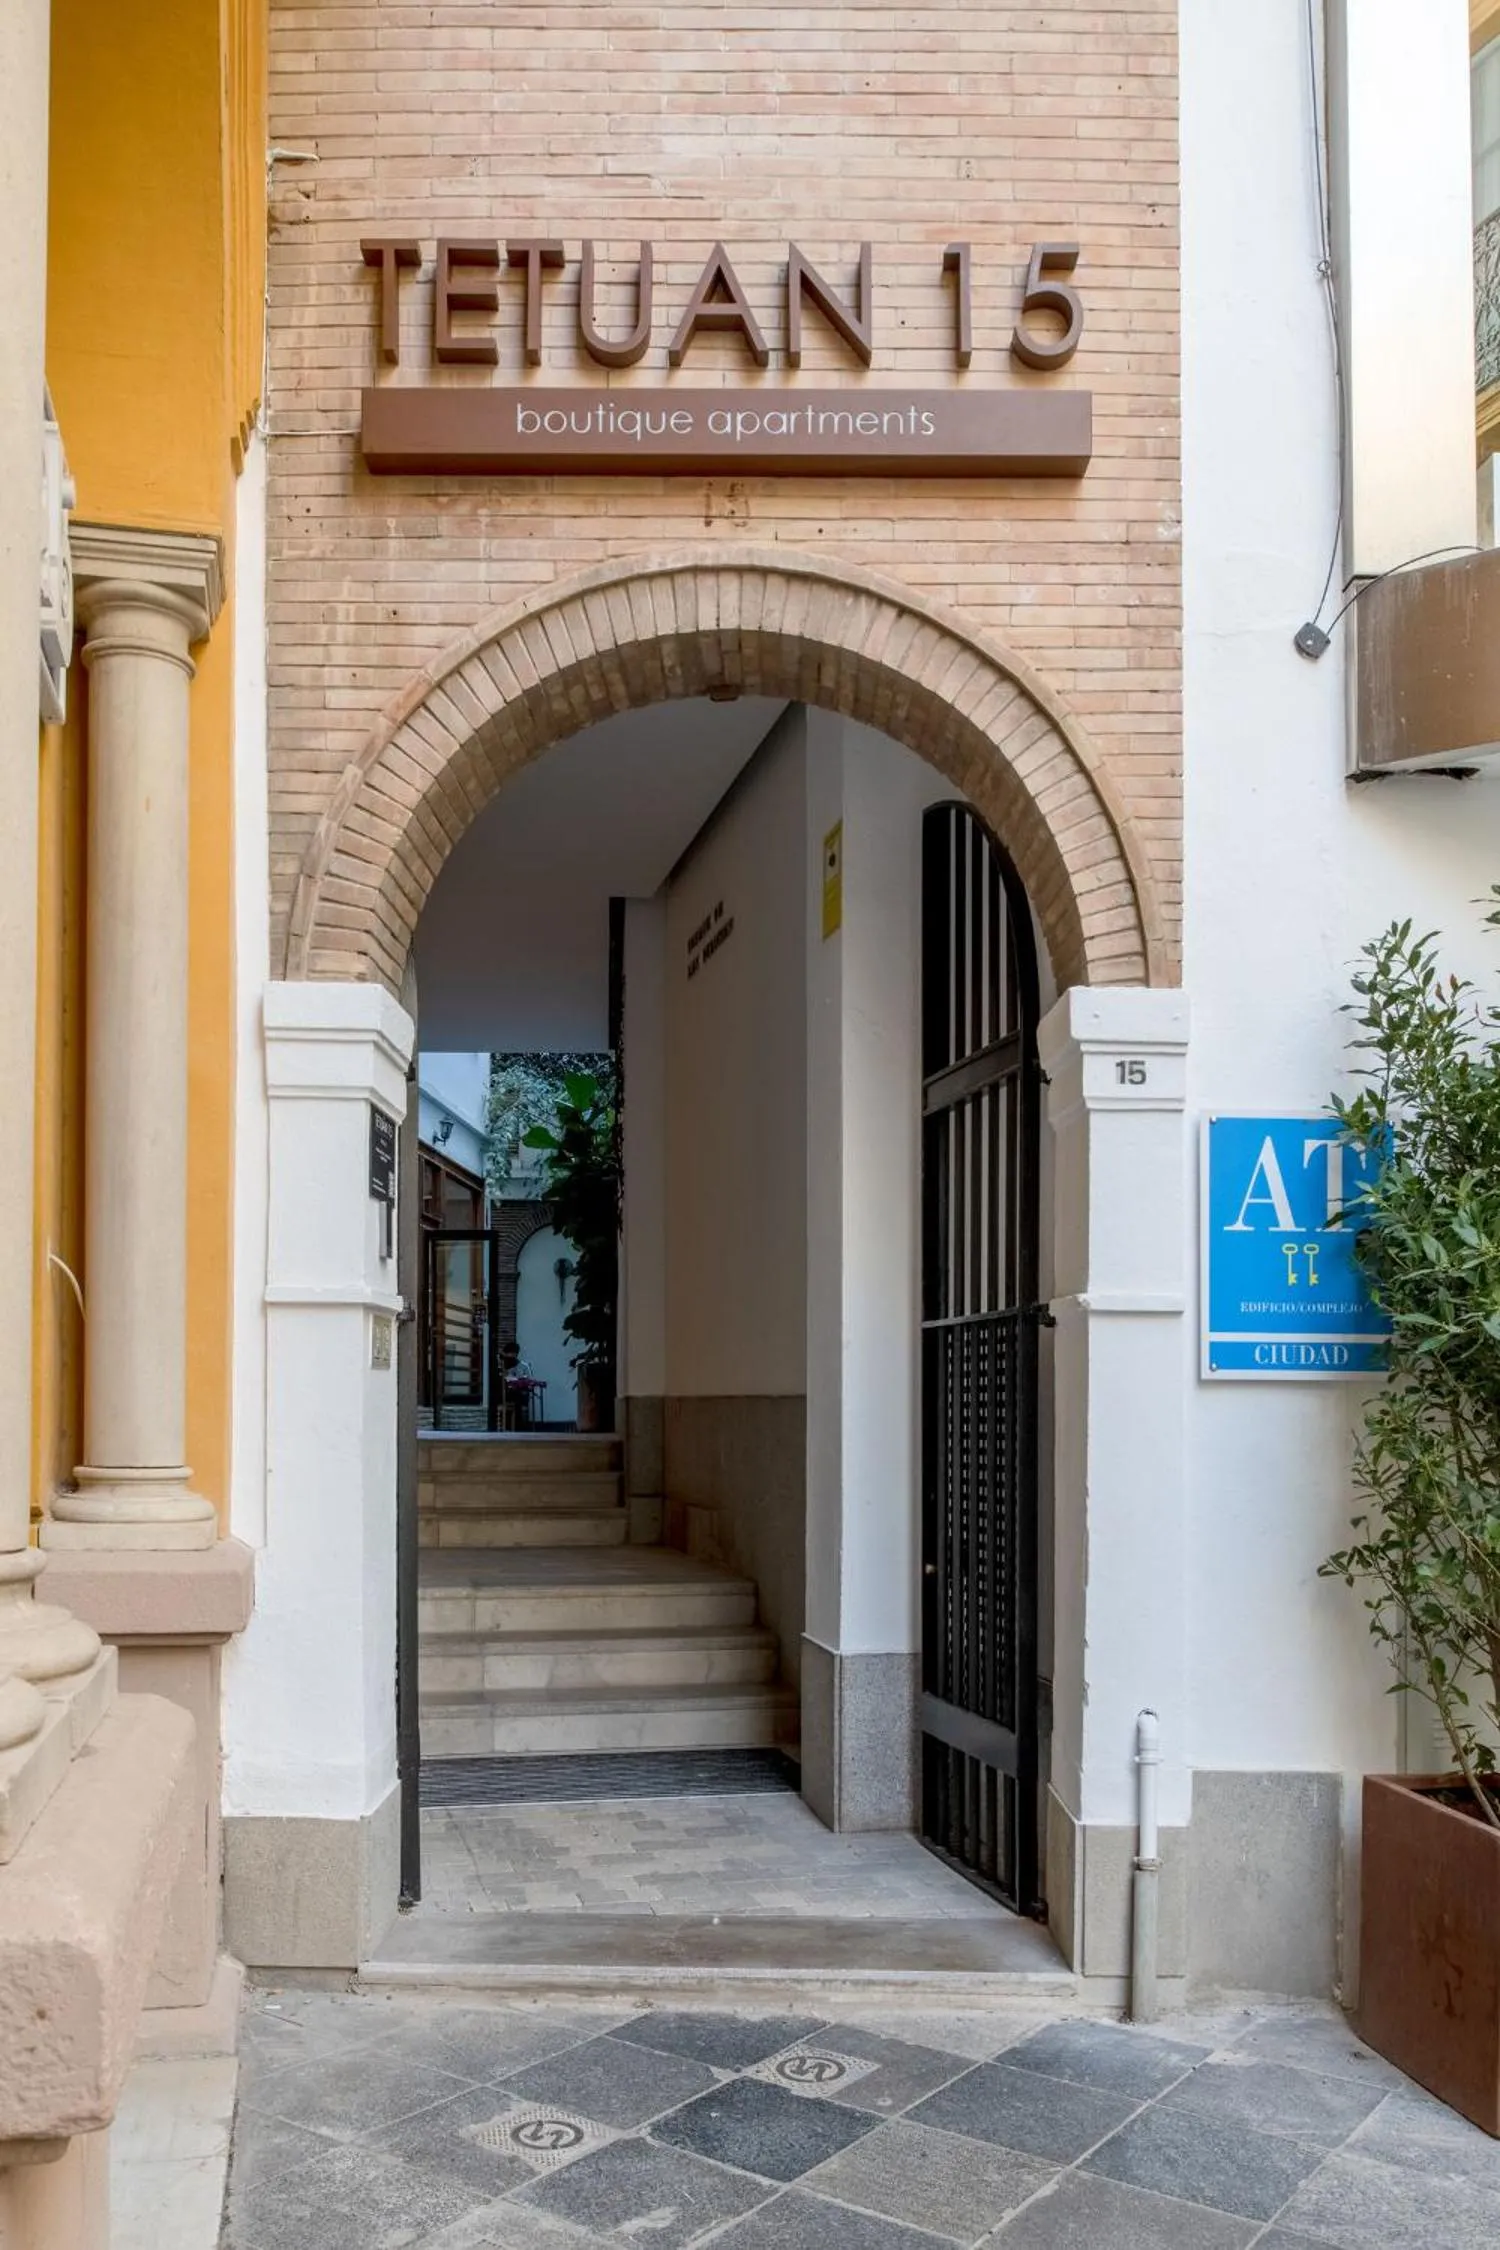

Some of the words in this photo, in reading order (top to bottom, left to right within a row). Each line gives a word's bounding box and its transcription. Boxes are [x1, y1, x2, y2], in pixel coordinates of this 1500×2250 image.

[360, 238, 873, 369] TETUAN
[942, 241, 1085, 371] 15
[516, 402, 694, 442] boutique
[707, 404, 936, 442] apartments
[1115, 1060, 1147, 1085] 15
[1223, 1135, 1368, 1233] AT
[1254, 1343, 1349, 1365] CIUDAD
